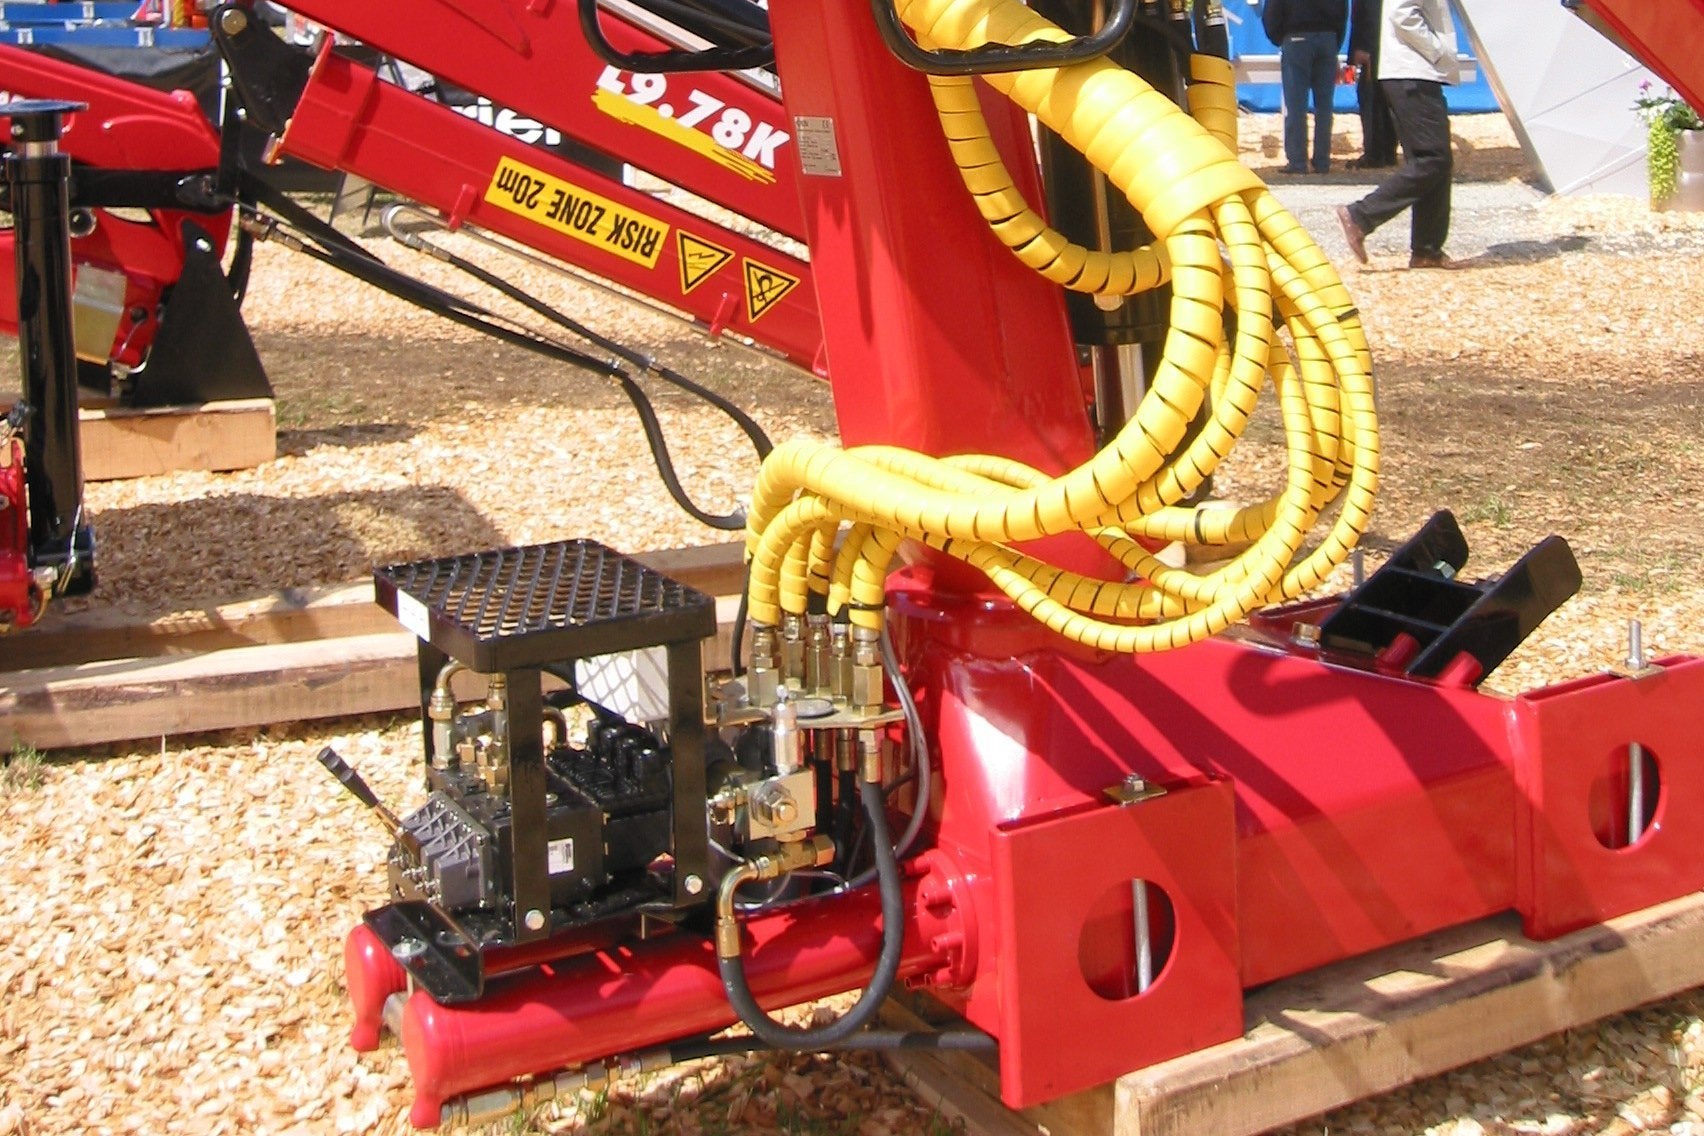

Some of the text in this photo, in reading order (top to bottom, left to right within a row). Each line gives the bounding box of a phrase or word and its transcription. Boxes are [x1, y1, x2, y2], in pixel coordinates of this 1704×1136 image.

[596, 64, 791, 170] L9.78K
[496, 166, 661, 259] RISK ZONE 20m
